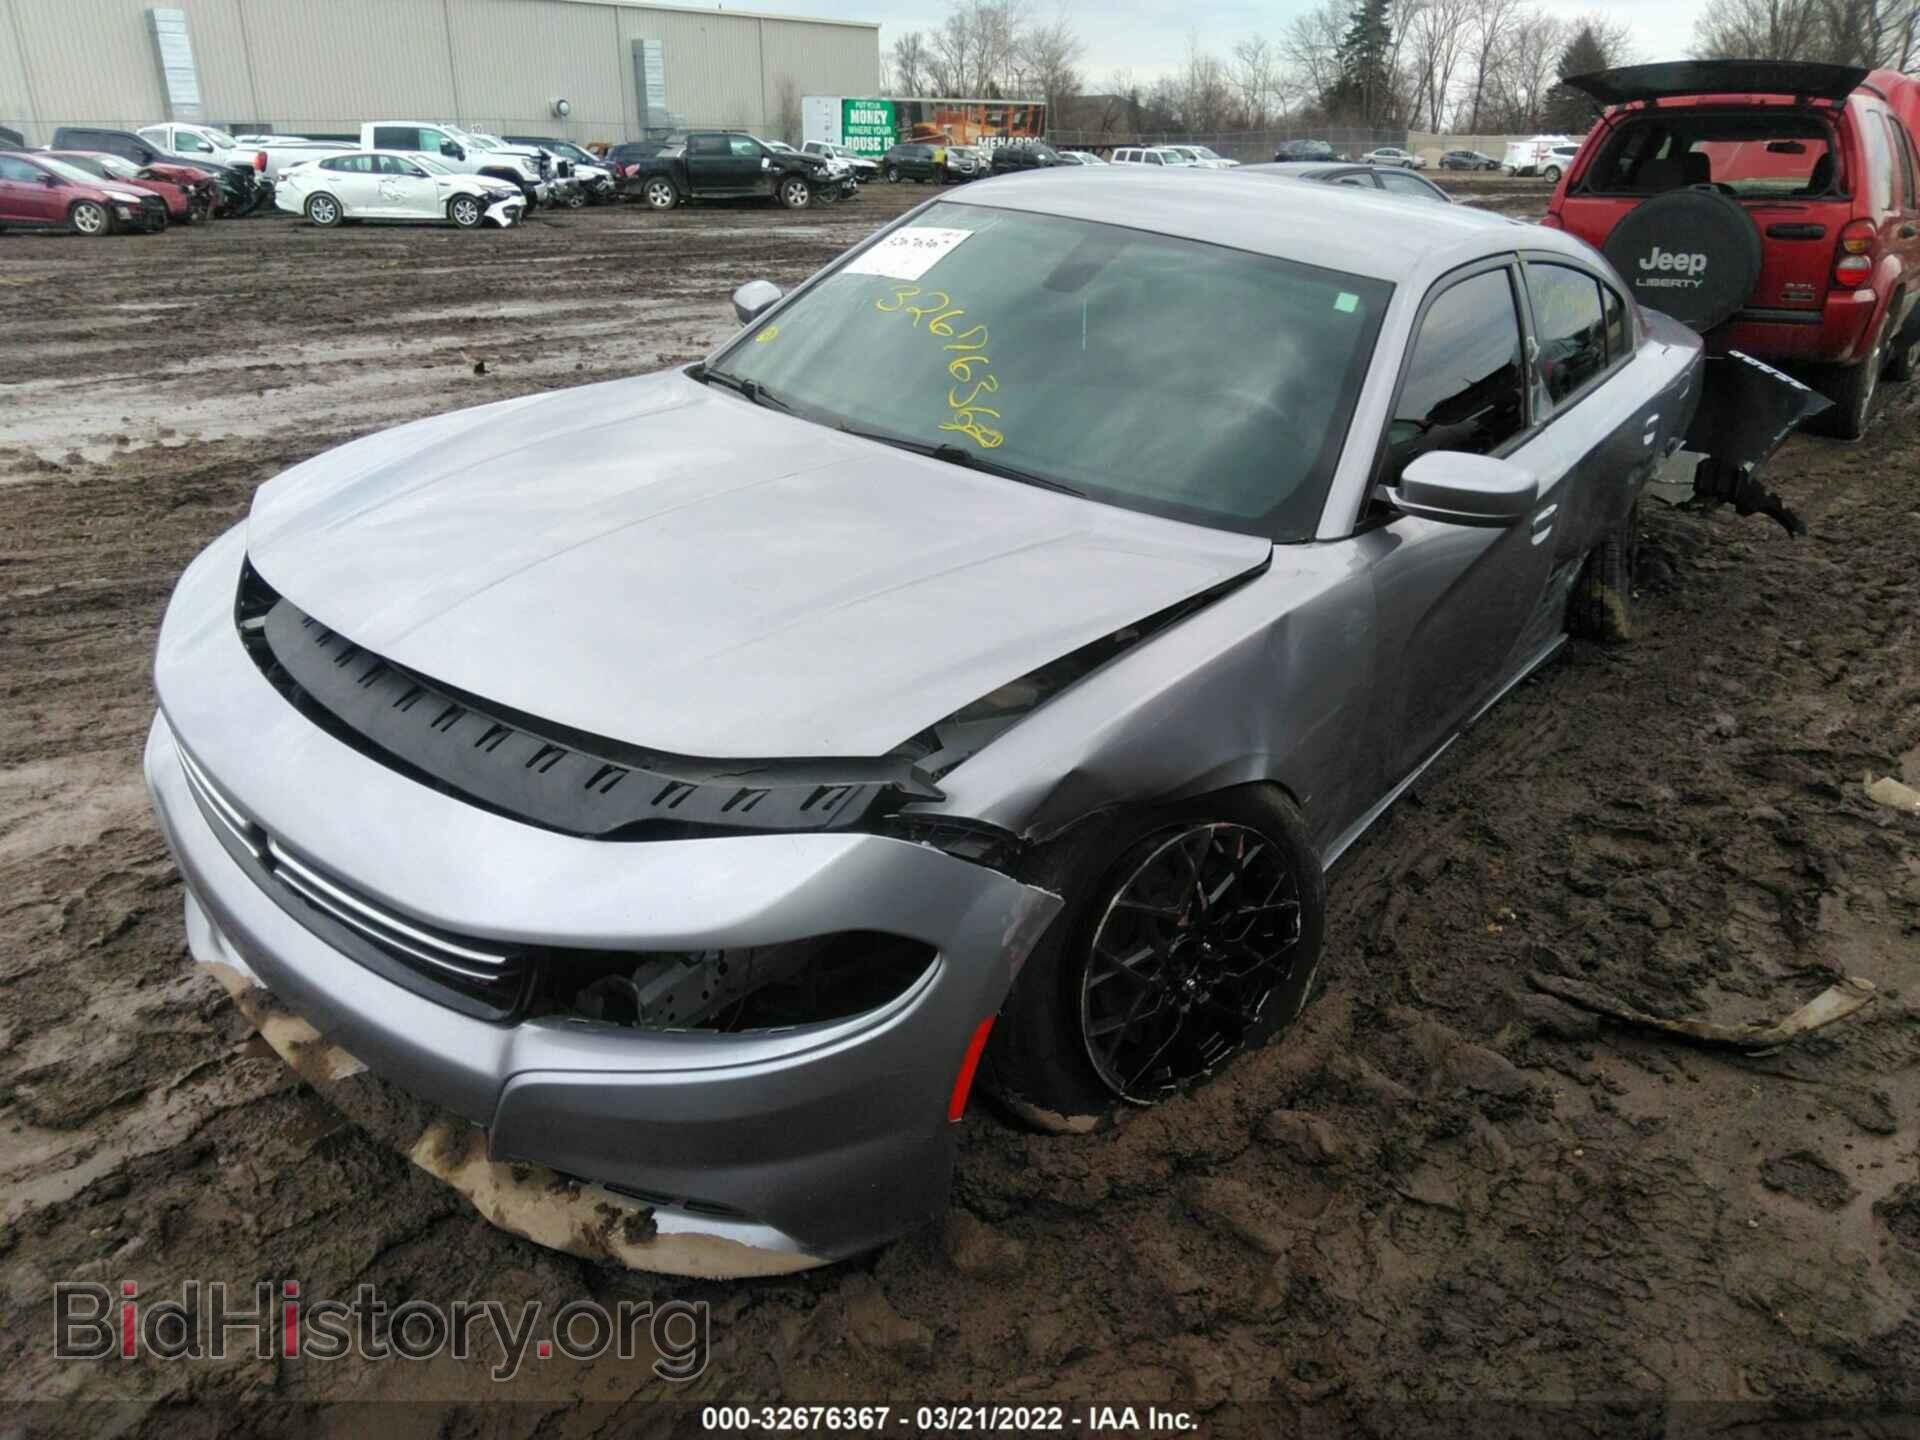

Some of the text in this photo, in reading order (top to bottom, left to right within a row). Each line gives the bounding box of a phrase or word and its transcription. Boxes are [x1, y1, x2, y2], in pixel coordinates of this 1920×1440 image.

[850, 109, 888, 125] MONEY
[848, 126, 892, 136] WHERE YOUR
[1639, 247, 1707, 276] Jeep
[1636, 278, 1704, 288] LIBERTY
